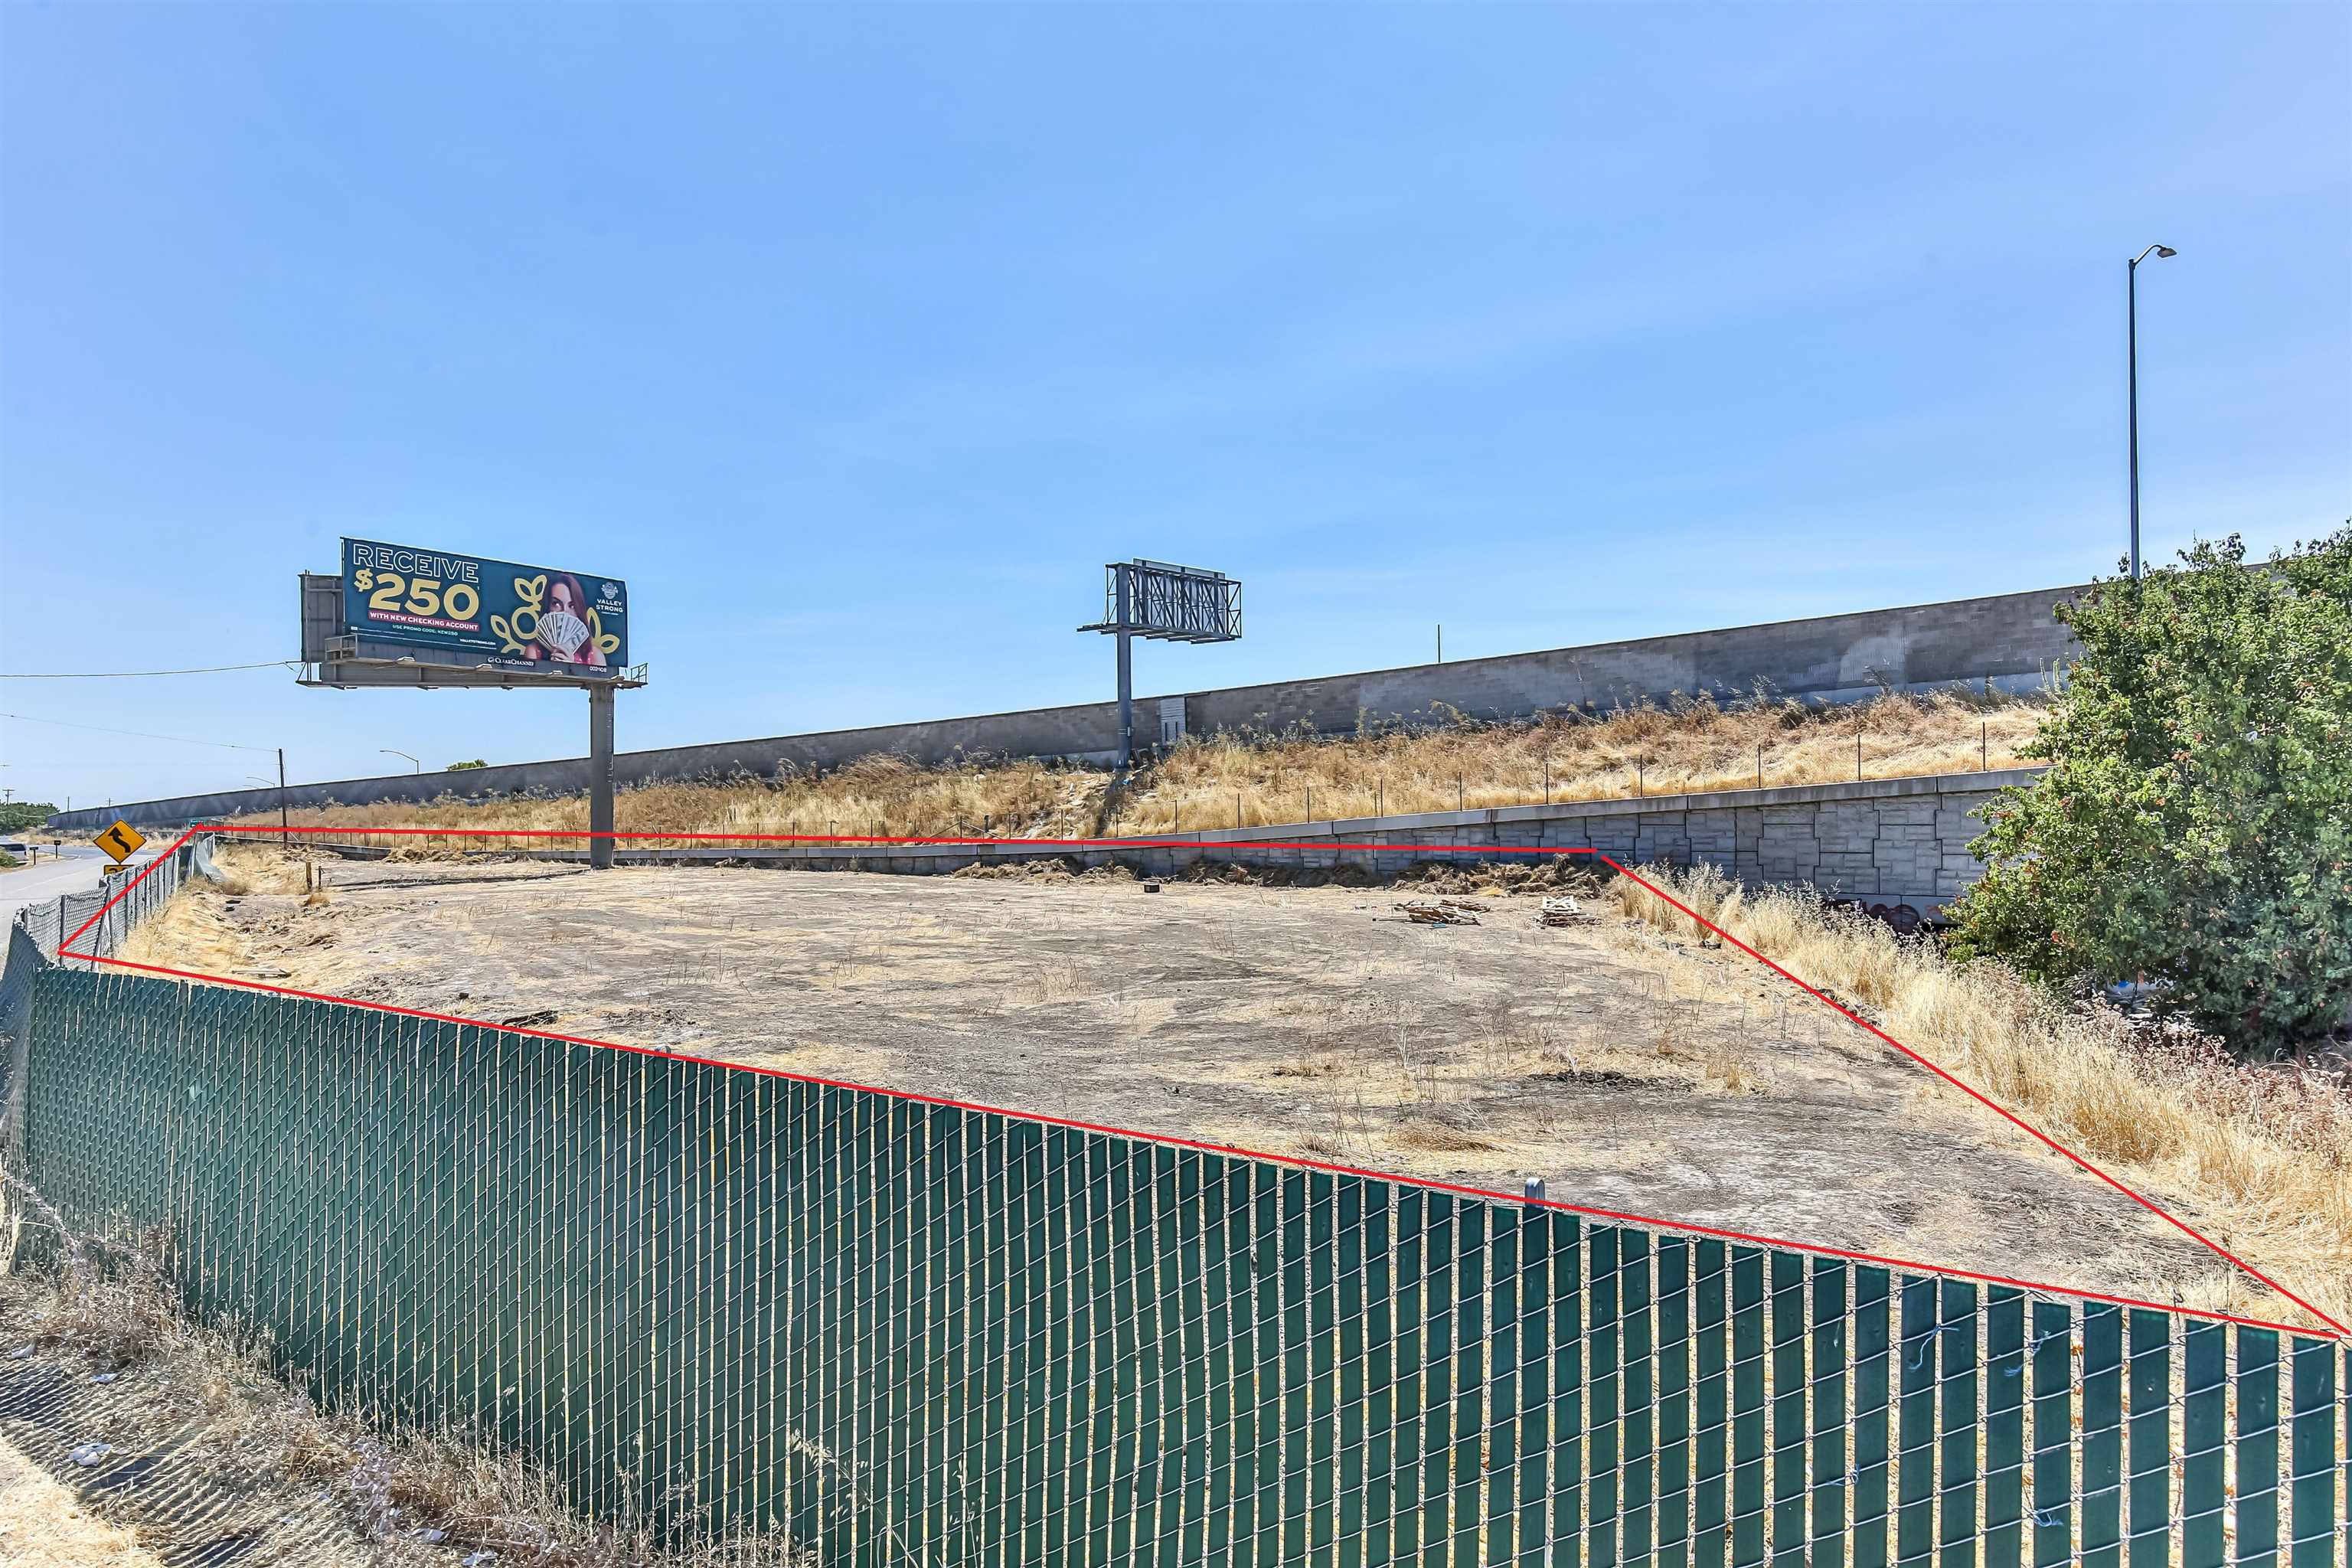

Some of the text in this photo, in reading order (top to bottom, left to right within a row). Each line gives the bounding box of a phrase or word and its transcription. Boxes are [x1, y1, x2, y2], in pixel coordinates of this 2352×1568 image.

[353, 544, 479, 583] RECEIVE
[596, 604, 624, 613] STRONG
[370, 612, 389, 620] WITH
[407, 616, 445, 626] CHECKING
[446, 622, 479, 631] ACCOUNT
